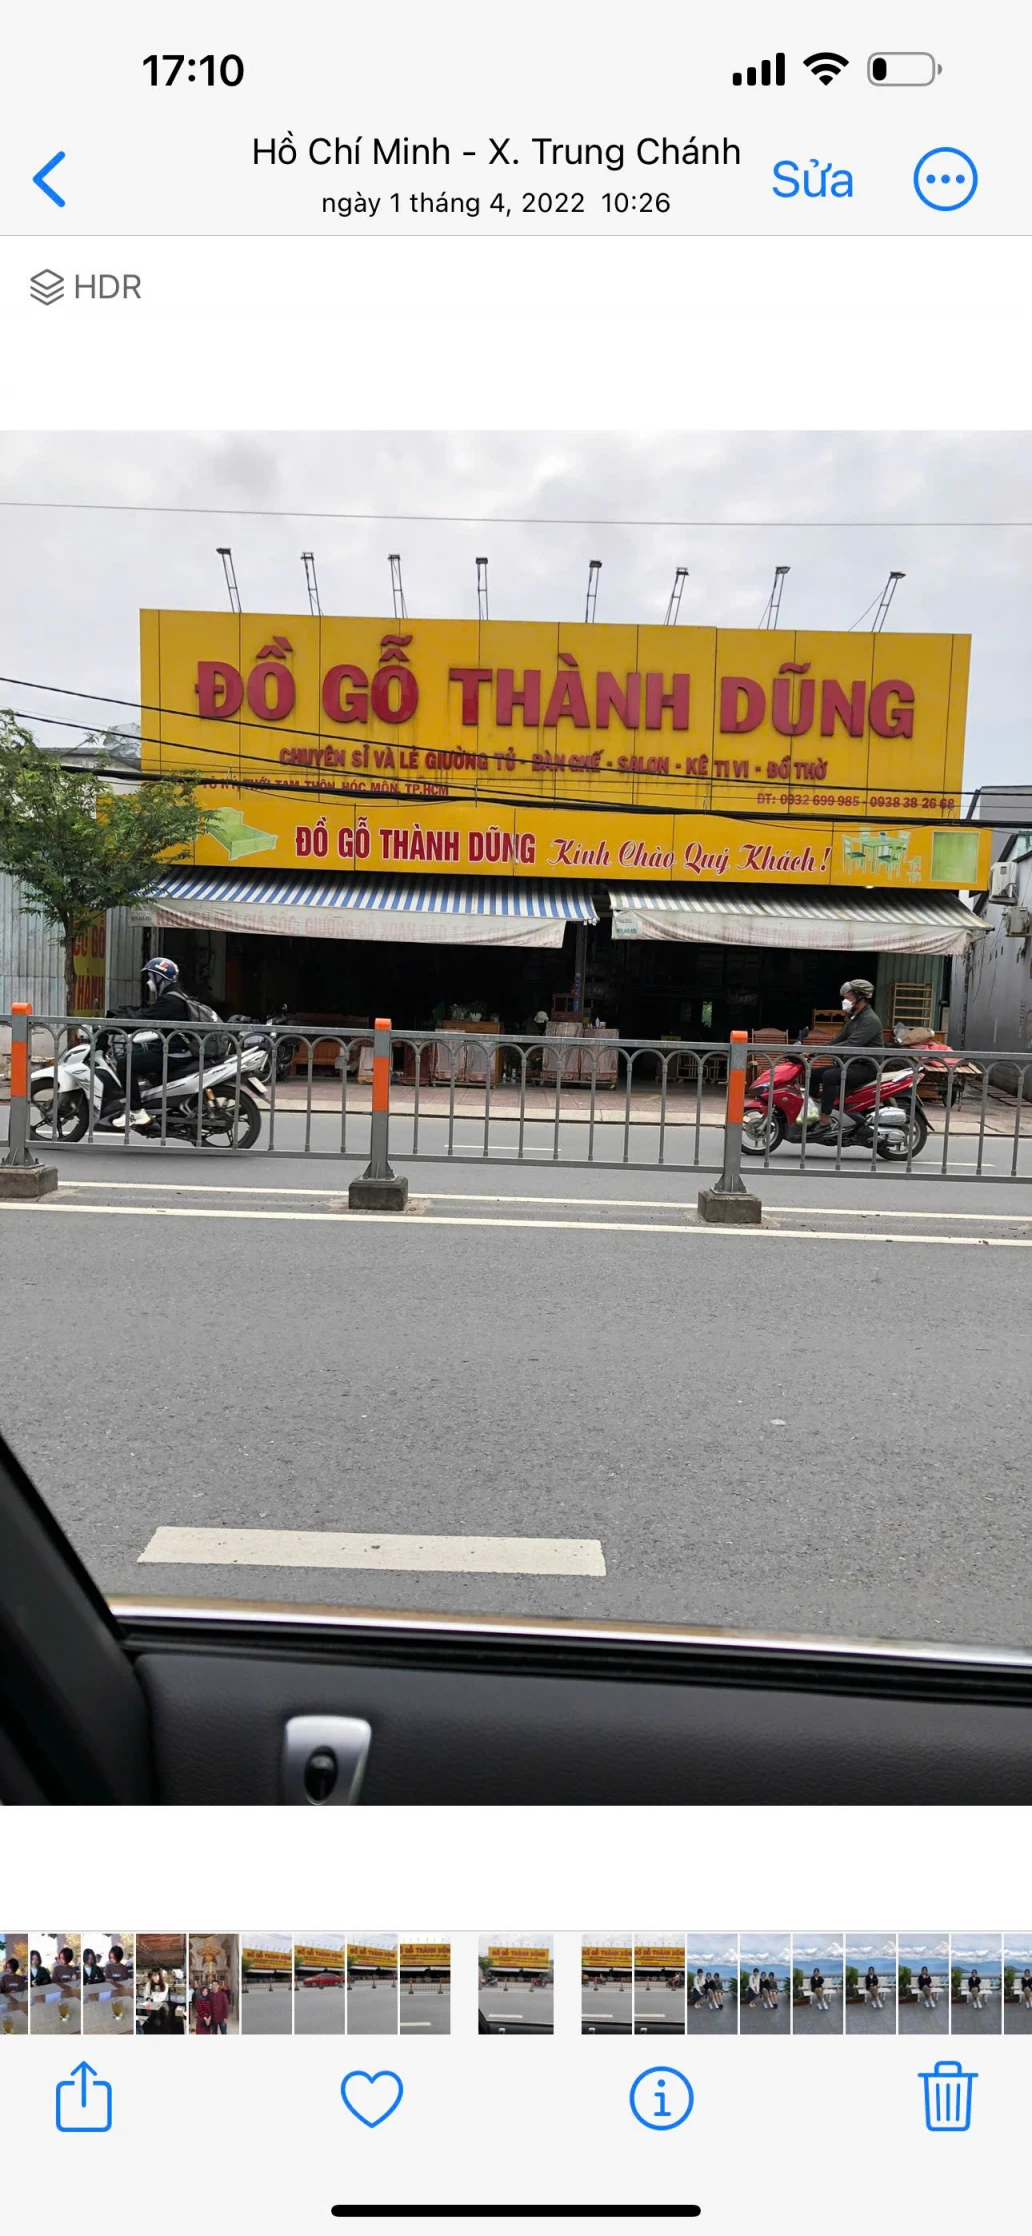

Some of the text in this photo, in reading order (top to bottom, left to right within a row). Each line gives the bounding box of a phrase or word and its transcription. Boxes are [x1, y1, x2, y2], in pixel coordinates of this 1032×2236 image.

[194, 634, 916, 738] ĐỒ GỖ THÀNH DŨNG
[279, 744, 346, 767] CHUYÊN
[374, 746, 396, 769] VÀ
[531, 749, 566, 772] BÀN
[568, 749, 604, 773] GHẾ
[617, 755, 670, 774] SALON
[714, 760, 730, 778] TI
[733, 760, 749, 778] VI
[794, 757, 829, 780] THỜ
[404, 783, 449, 796] TP.HCM
[780, 793, 809, 806] 0932
[812, 794, 835, 806] 699
[837, 795, 860, 807] 985
[869, 796, 901, 808] 0938
[902, 797, 918, 808] 38
[921, 797, 937, 809] 26
[296, 816, 536, 864] ĐỒ GỖ THÀNH DŨNG
[547, 838, 612, 867] Kính
[618, 840, 676, 868] Chào
[684, 841, 731, 876] Quý
